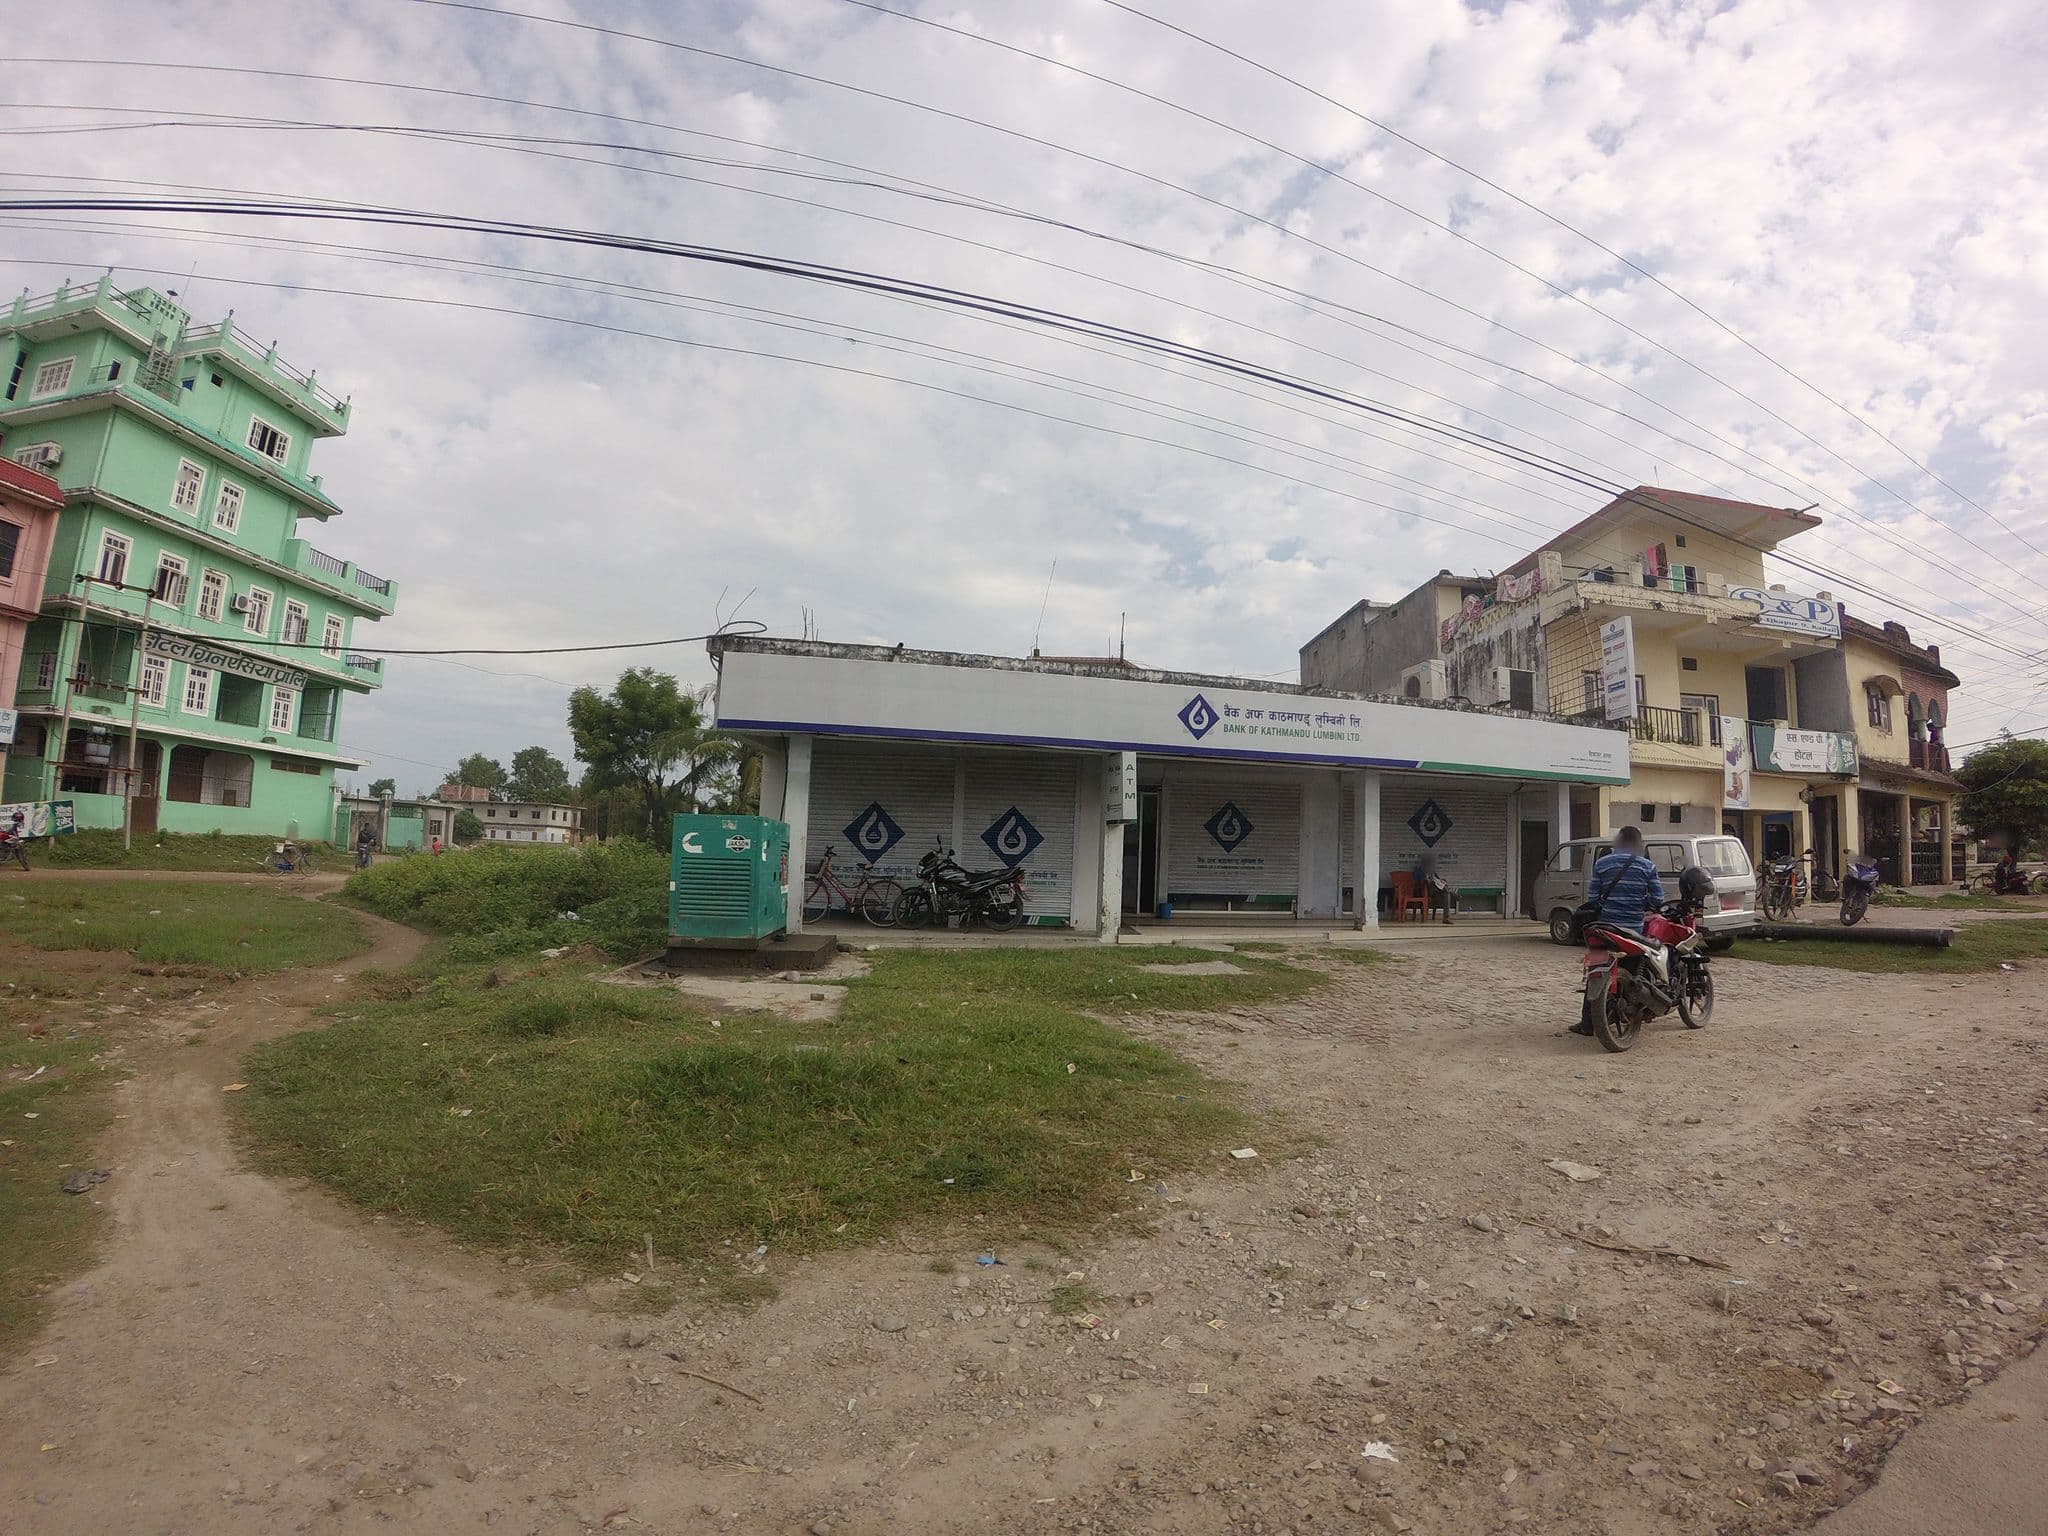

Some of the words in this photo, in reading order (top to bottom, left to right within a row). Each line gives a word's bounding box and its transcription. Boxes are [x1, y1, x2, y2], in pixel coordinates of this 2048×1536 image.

[1776, 601, 1793, 613] &
[1808, 601, 1828, 619] P
[1244, 708, 1265, 720] अफ
[1223, 723, 1247, 734] BANK
[1248, 725, 1259, 735] OF
[1260, 725, 1311, 739] KATHMANDU
[1312, 729, 1345, 741] LUMBINI
[1347, 732, 1360, 742] LTD
[1794, 748, 1813, 761] होटल
[1125, 763, 1136, 800] ATM
